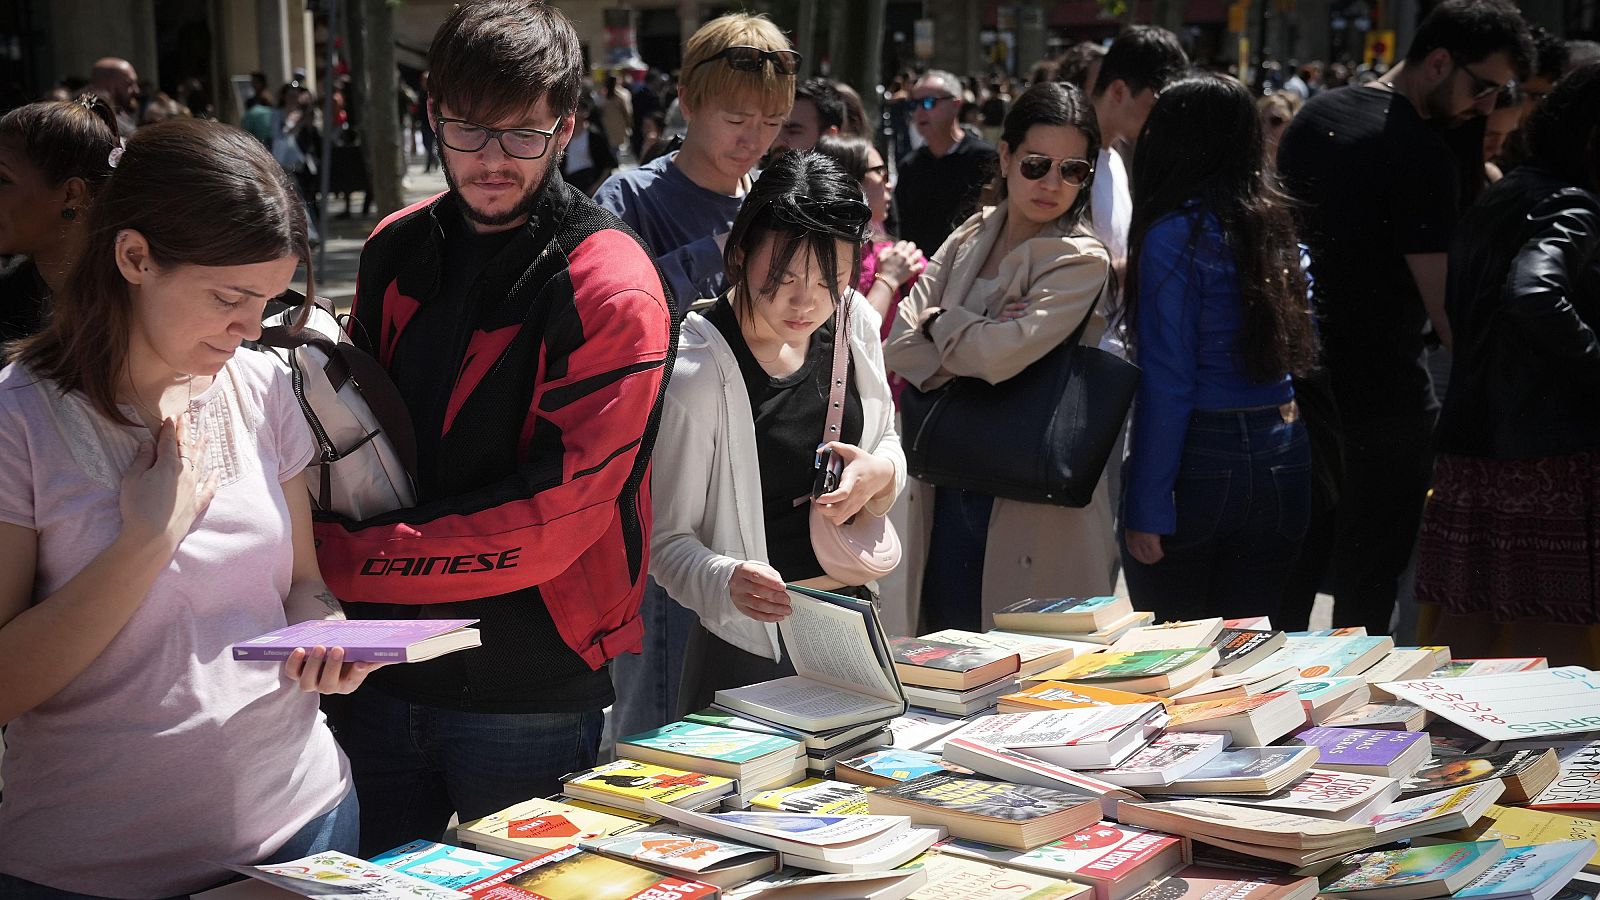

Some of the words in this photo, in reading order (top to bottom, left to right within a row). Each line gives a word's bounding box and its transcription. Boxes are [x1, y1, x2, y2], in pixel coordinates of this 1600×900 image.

[360, 548, 522, 577] DAINESE
[1442, 701, 1493, 713] 20€
[1469, 714, 1506, 725] 8€
